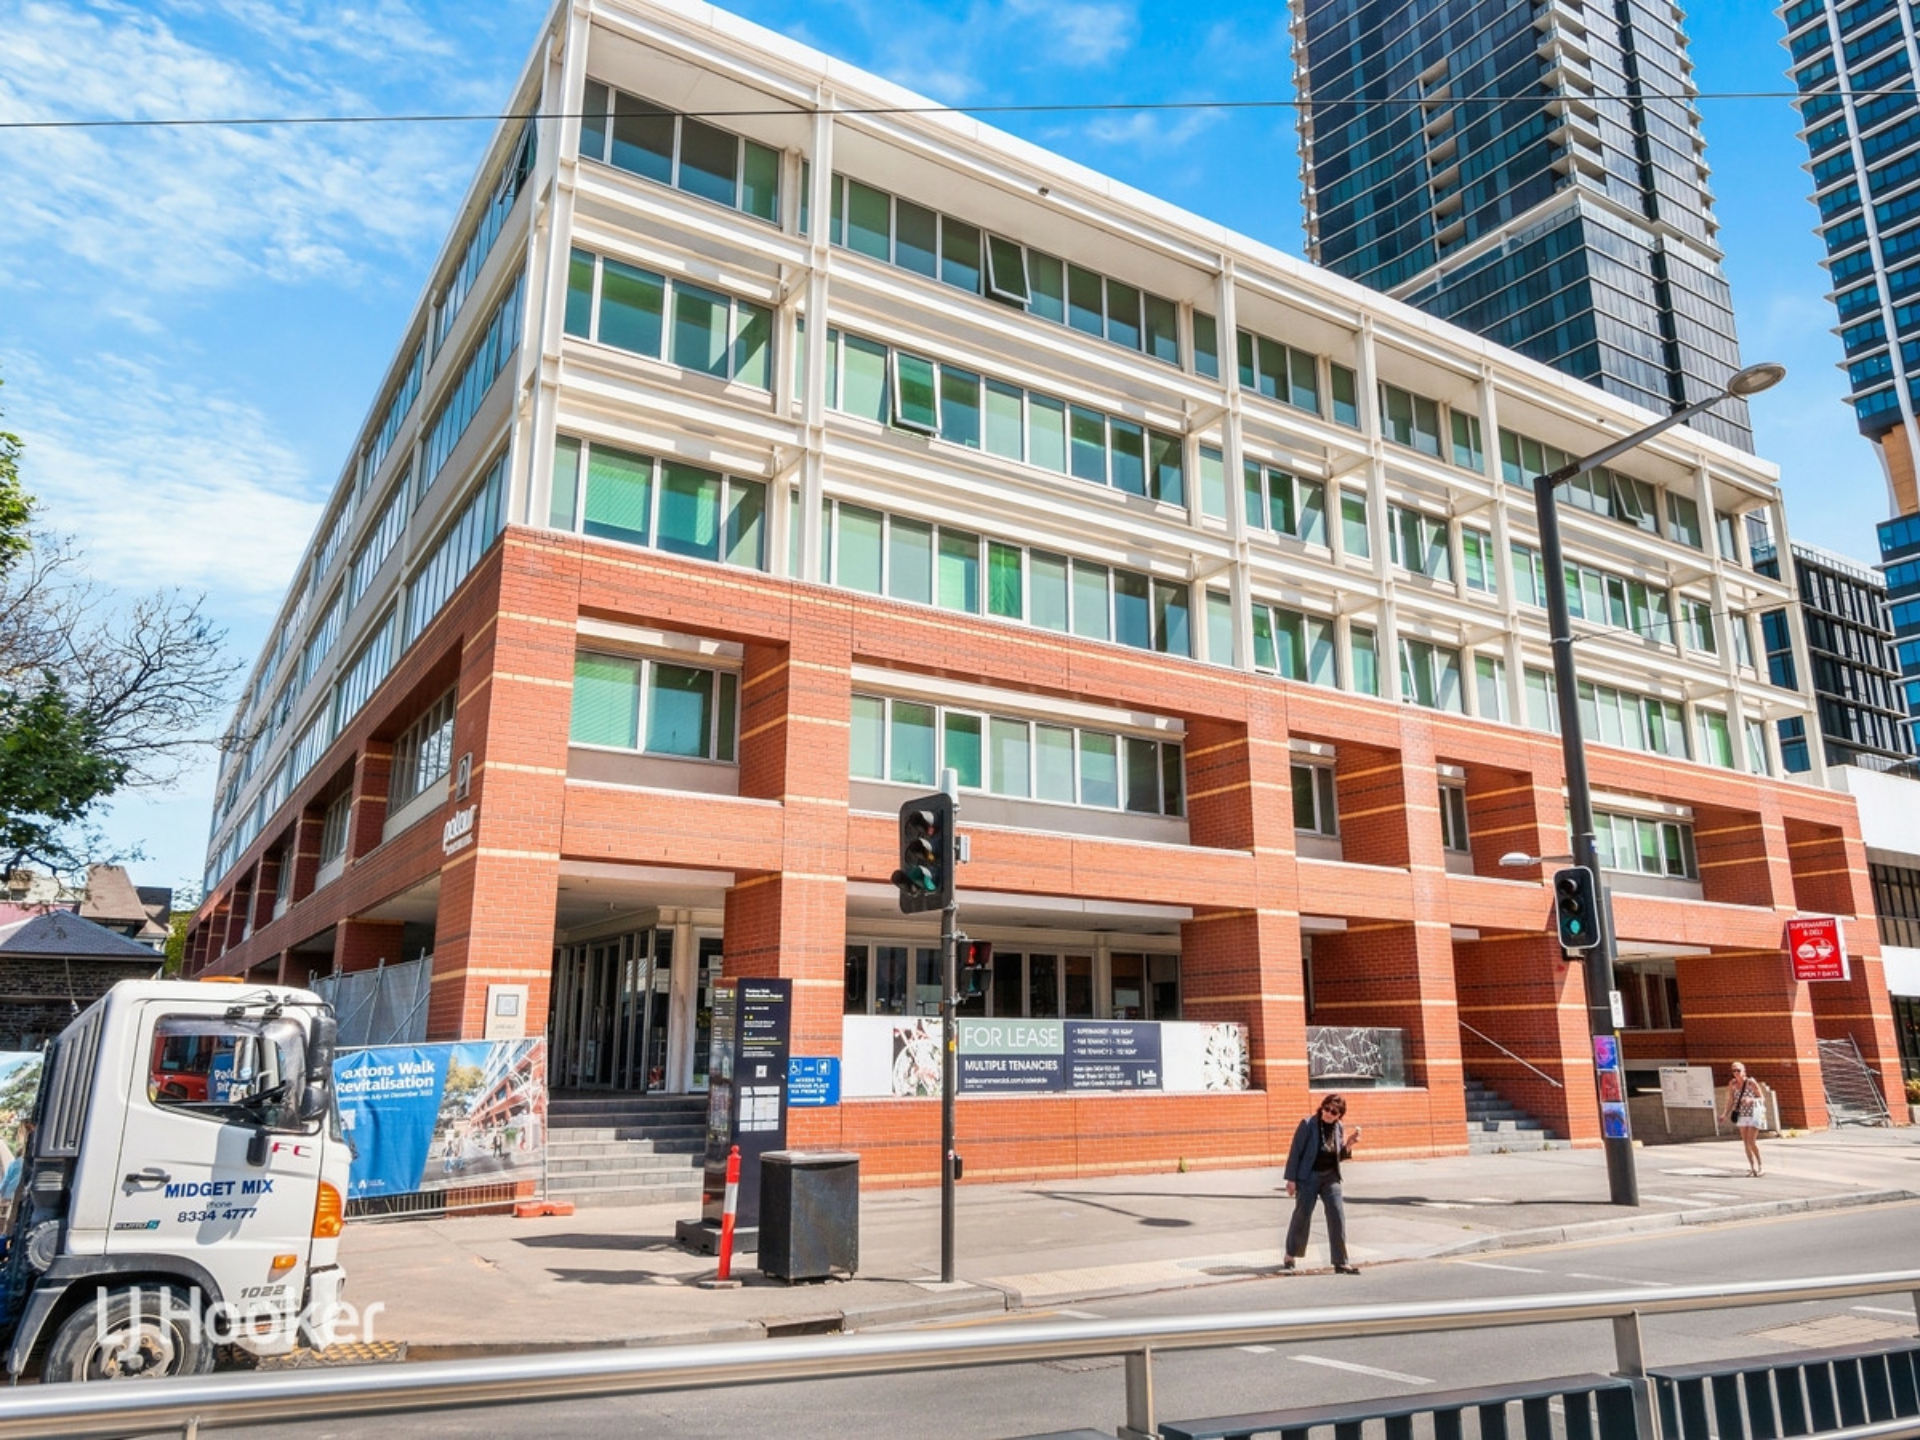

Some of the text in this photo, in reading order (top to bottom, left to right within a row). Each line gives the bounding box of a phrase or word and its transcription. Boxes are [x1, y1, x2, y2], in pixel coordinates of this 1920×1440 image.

[1790, 920, 1834, 929] SUPERMARKET
[1809, 928, 1823, 936] DELI
[964, 1026, 1059, 1048] FOR LEASE
[398, 1060, 435, 1075] Walk
[965, 1060, 1058, 1071] MULTIPLE TENANCIES
[337, 1075, 435, 1094] Revitalisation
[391, 1091, 419, 1099] December
[164, 1178, 274, 1198] MIDGET MIX
[177, 1207, 257, 1223] 8334 4777
[241, 1285, 286, 1299] 1022
